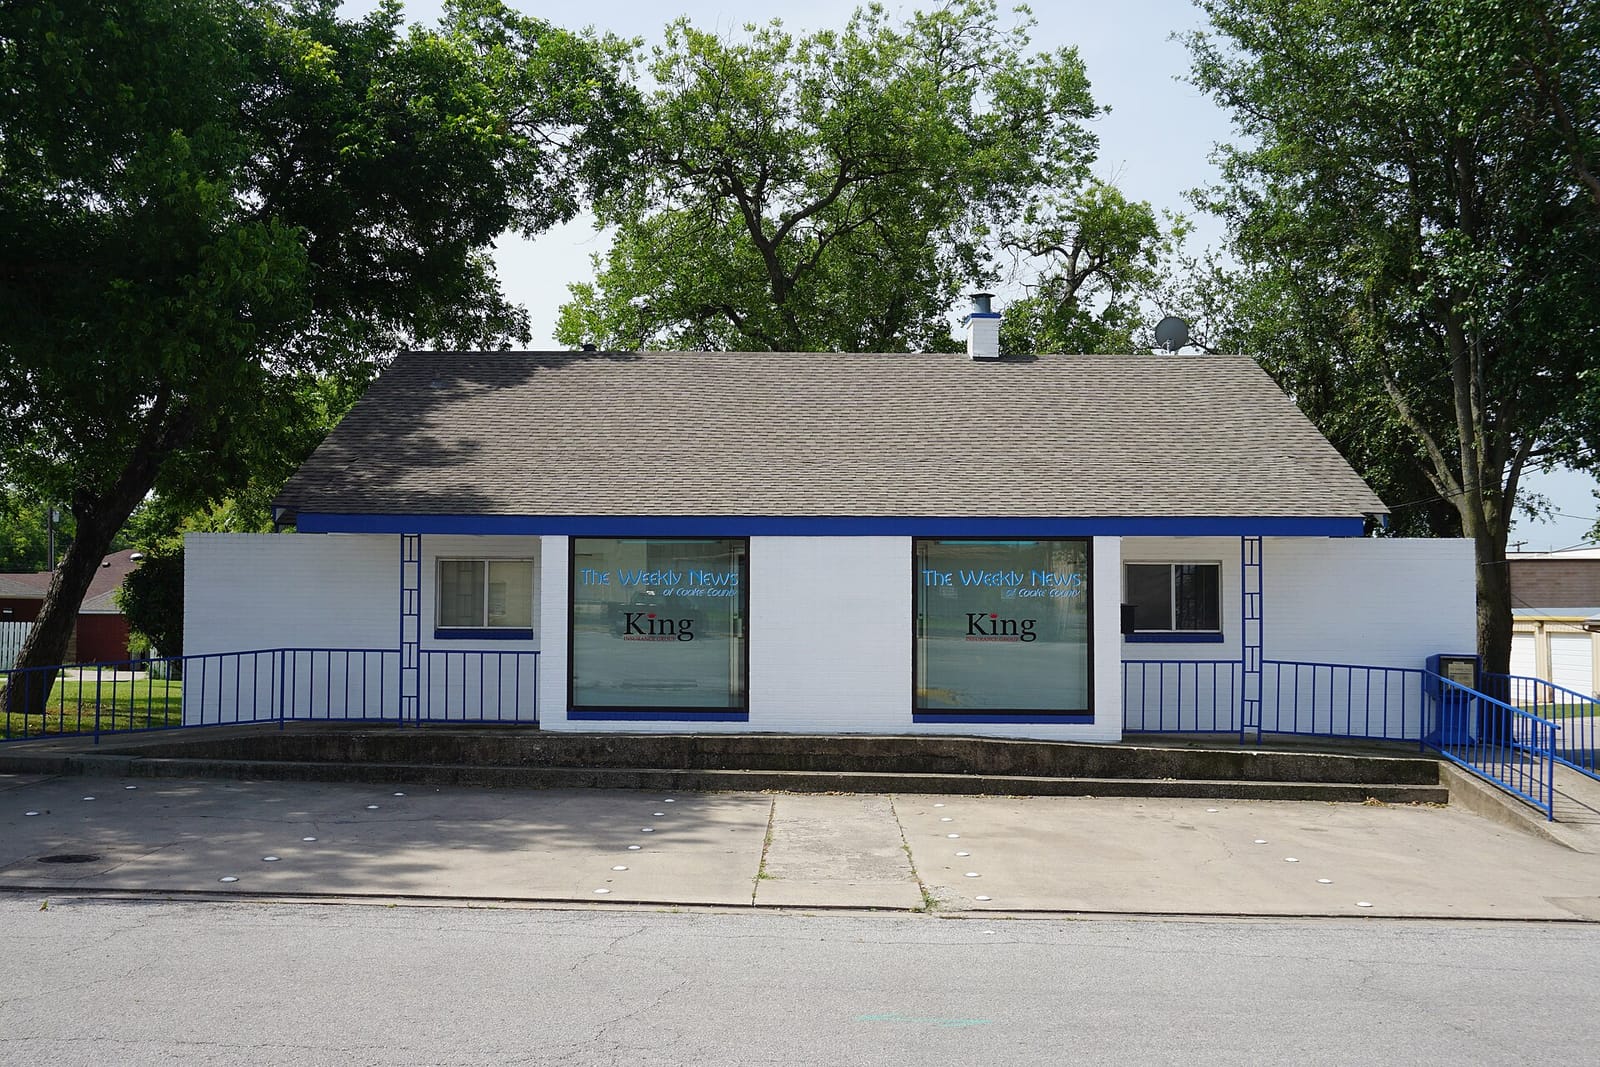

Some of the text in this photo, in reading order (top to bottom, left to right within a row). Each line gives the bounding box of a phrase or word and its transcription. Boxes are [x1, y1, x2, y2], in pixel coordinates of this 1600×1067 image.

[580, 567, 739, 586] The Weekly News
[921, 568, 1082, 587] The Weekly News
[623, 612, 694, 642] King
[966, 613, 1037, 643] King
